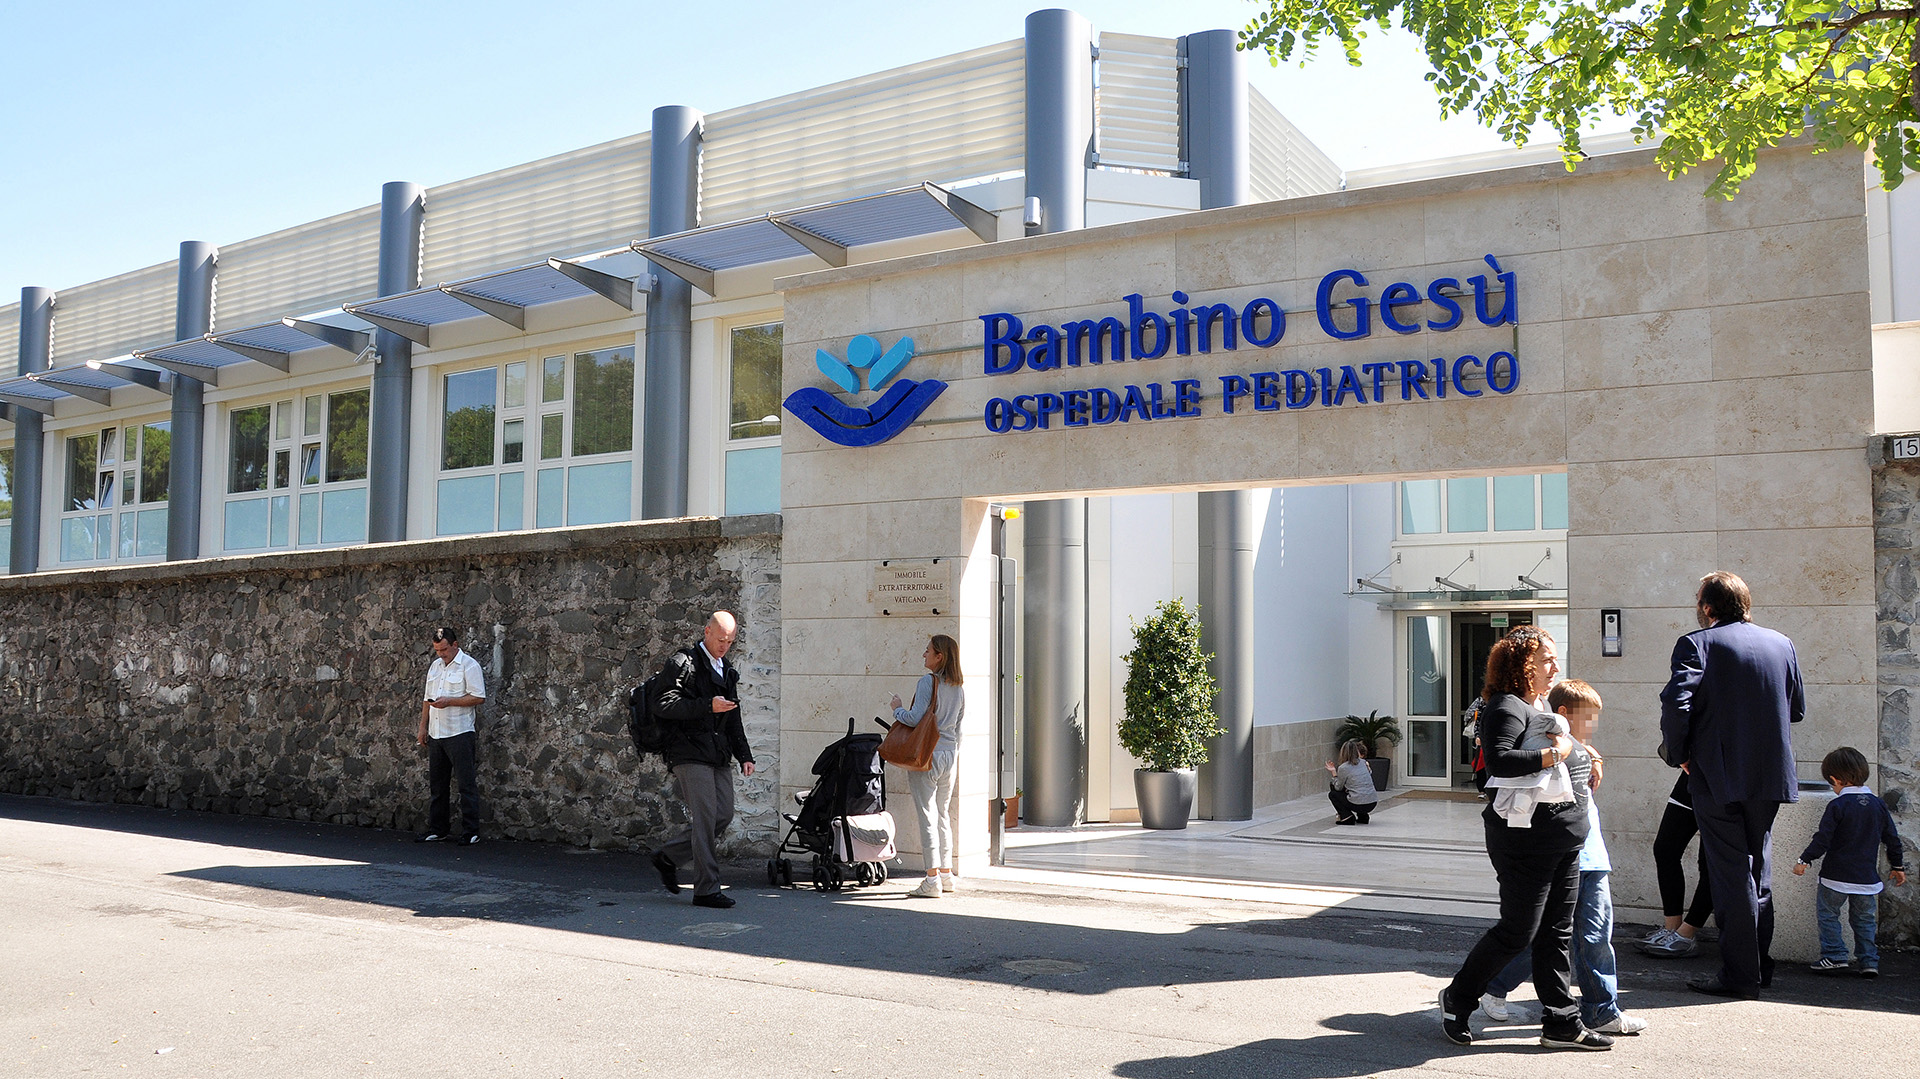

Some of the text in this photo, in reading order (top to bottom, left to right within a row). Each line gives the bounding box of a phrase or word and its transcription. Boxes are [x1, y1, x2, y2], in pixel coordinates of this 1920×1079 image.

[978, 252, 1519, 375] Bambino Gesù
[984, 351, 1521, 433] OSPEDALE PEDIATRICO
[1895, 439, 1919, 456] 15
[894, 571, 927, 579] IMMOBILE
[878, 583, 944, 591] EXTRATERRITORIALE
